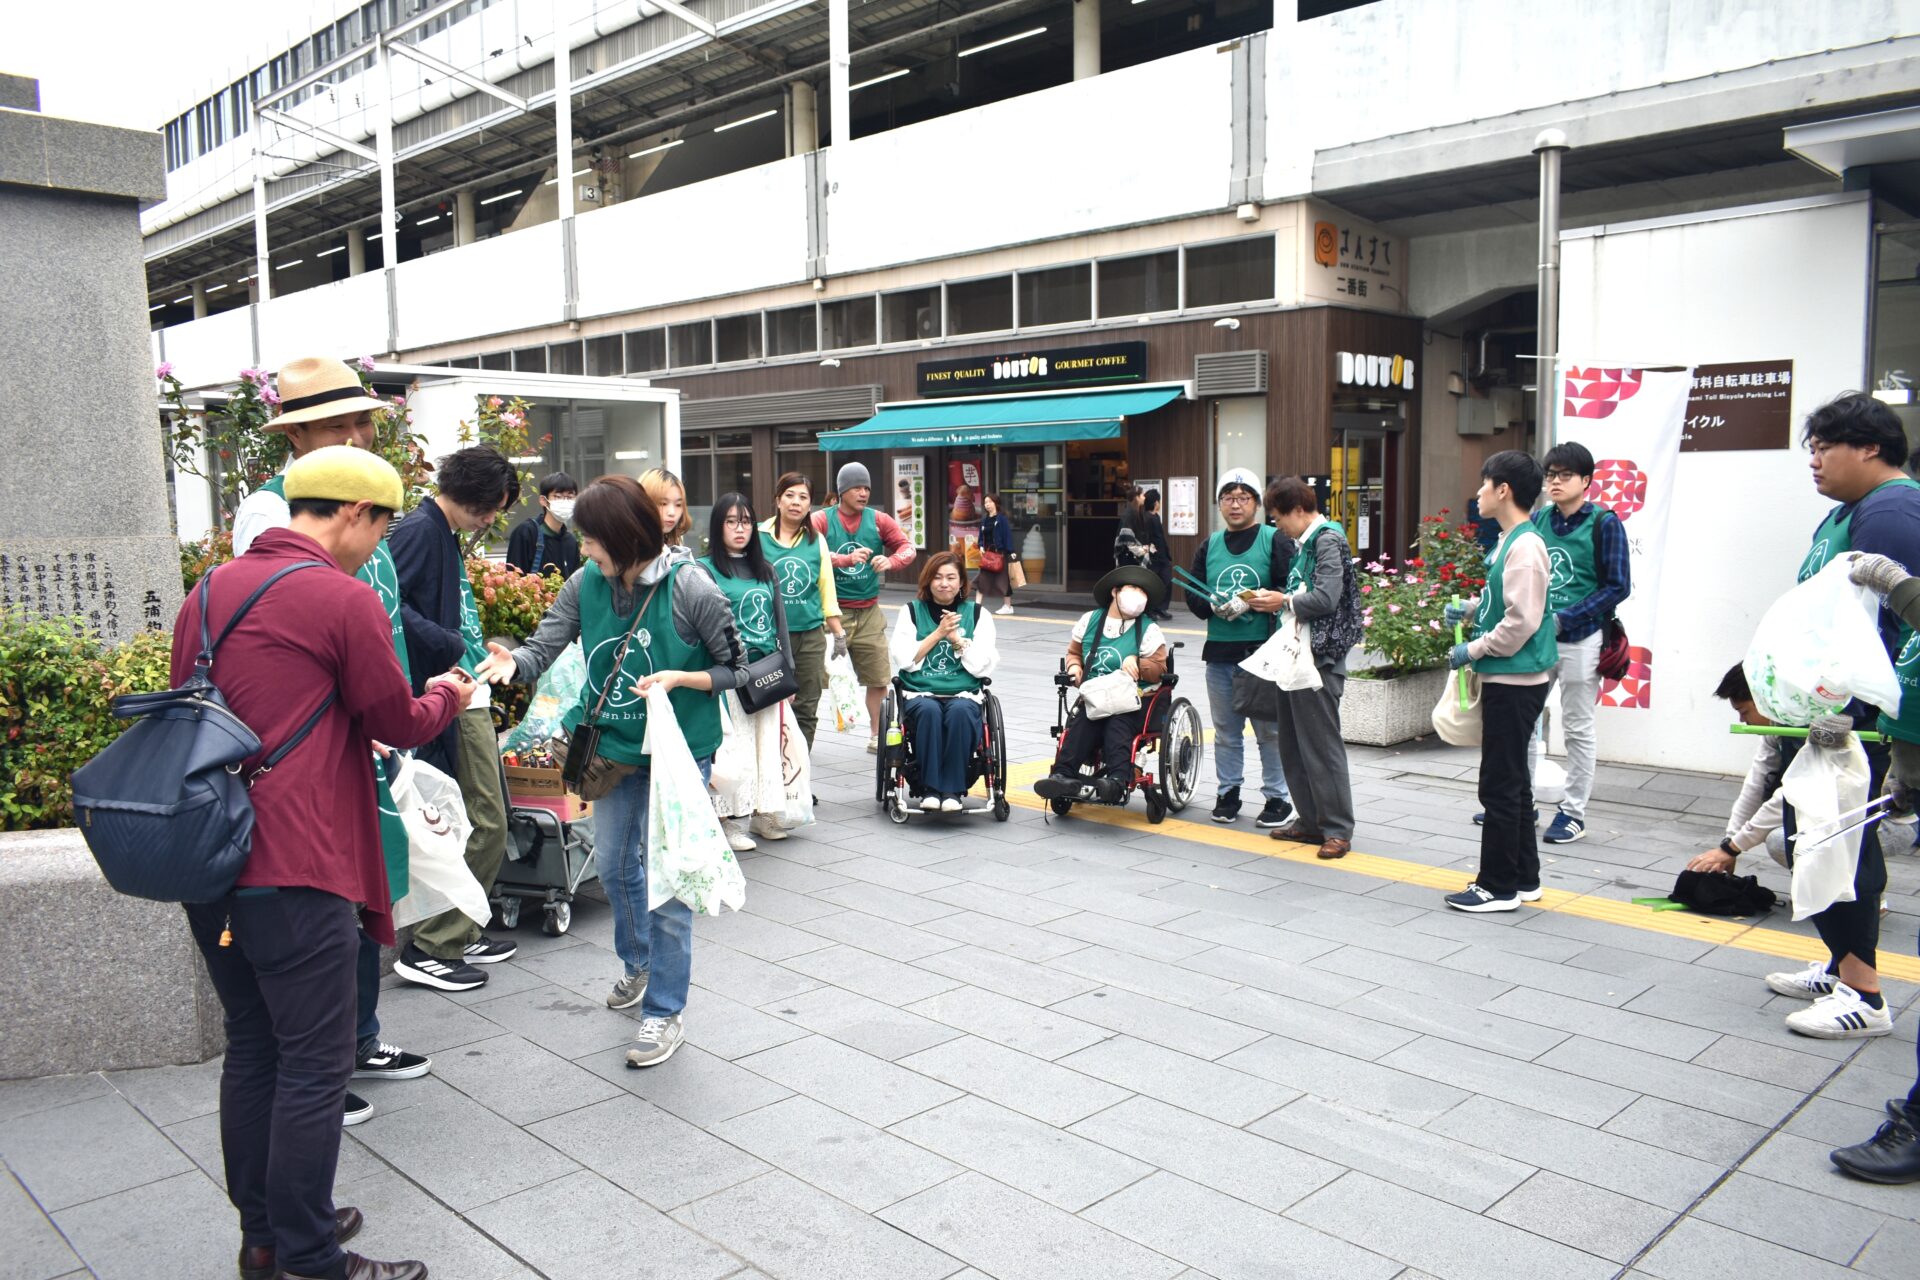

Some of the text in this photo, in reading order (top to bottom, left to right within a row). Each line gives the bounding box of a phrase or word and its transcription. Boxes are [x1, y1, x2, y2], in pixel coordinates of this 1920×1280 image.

[587, 187, 595, 199] 3
[1339, 227, 1391, 265] さんすて
[1337, 277, 1367, 297] 二番街
[993, 356, 1047, 379] DOUTOR
[1055, 355, 1127, 370] GOURMET COFFEE
[1338, 351, 1414, 390] DOUTOR
[926, 368, 986, 381] FINEST QUALITY
[754, 669, 784, 688] GUESS
